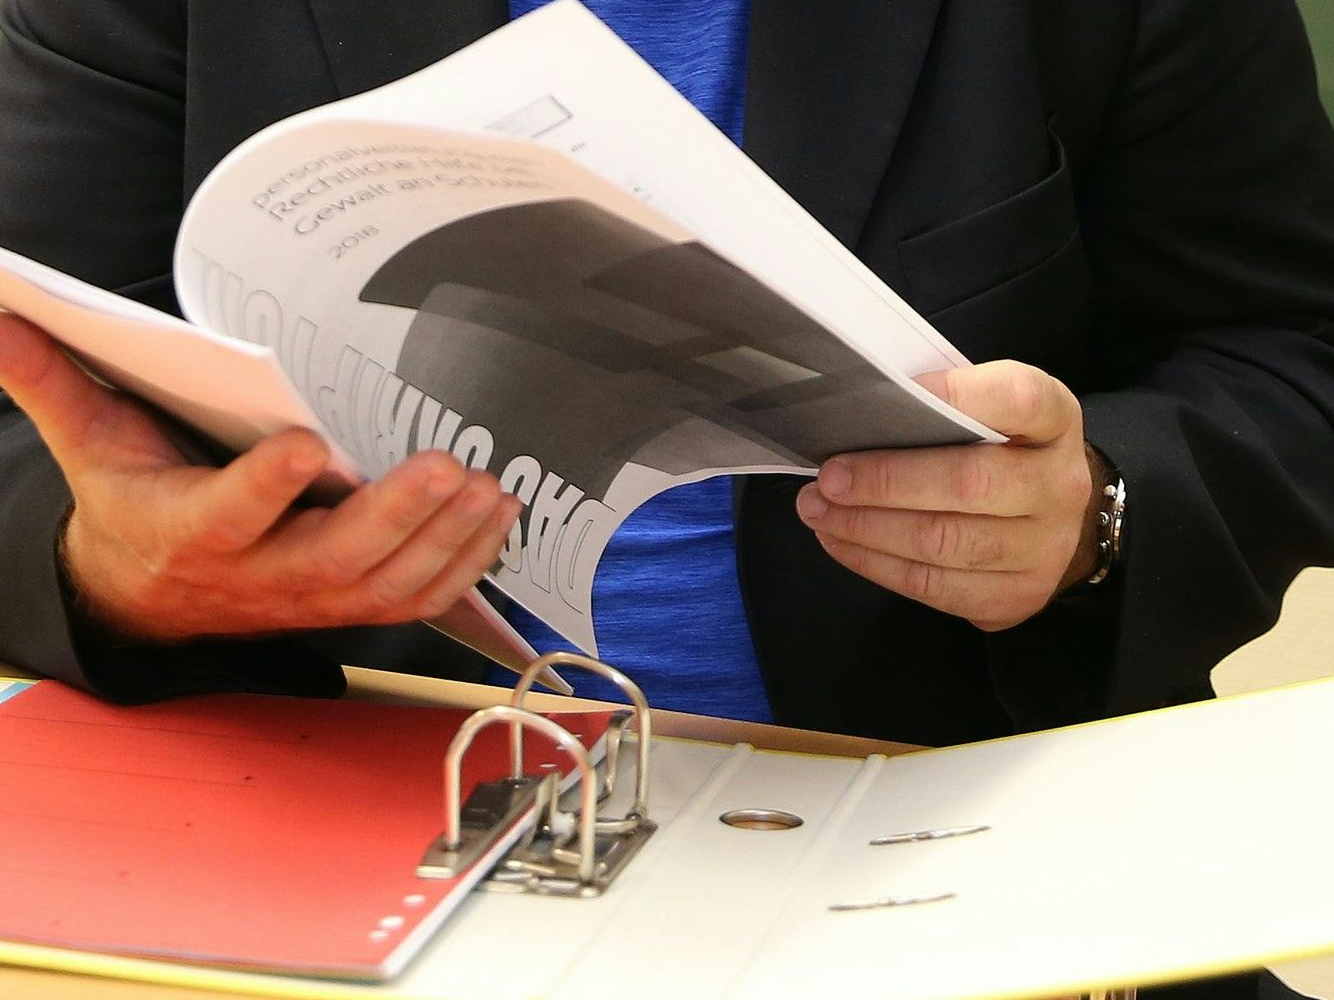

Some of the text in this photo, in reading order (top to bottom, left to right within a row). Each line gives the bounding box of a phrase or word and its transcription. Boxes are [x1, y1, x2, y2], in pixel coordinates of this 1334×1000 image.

[269, 160, 414, 221] Rechtliche
[294, 184, 392, 235] Gewalt
[397, 177, 435, 191] an
[499, 455, 618, 616] DAS
